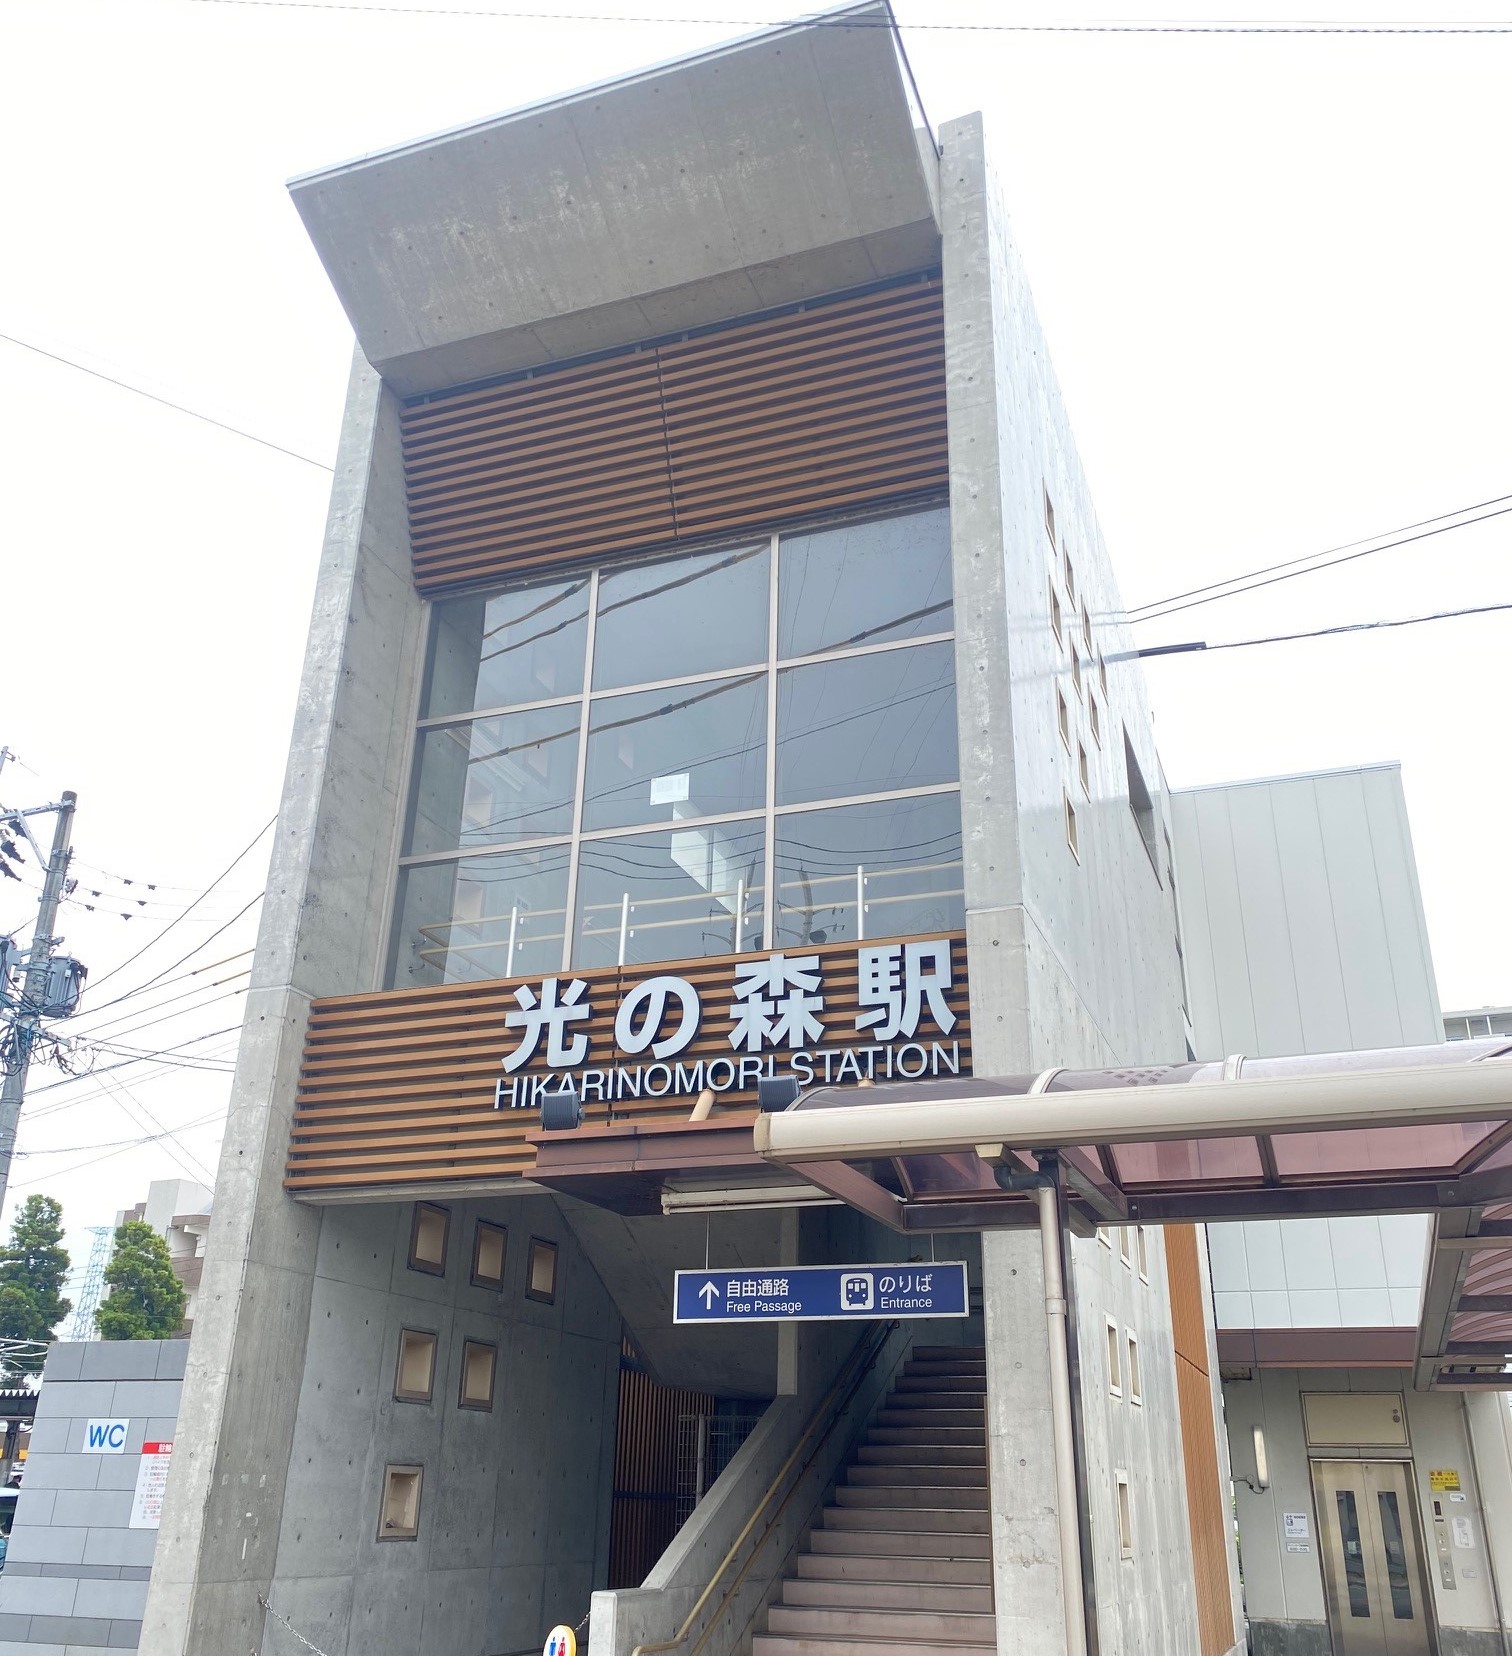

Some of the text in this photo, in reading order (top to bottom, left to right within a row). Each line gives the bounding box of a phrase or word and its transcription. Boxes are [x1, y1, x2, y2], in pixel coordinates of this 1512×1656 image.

[501, 939, 957, 1074] 光の森駅
[494, 1041, 960, 1110] HIKARINOMORI STATION
[726, 1279, 790, 1298] 自由通路
[879, 1273, 933, 1293] のりば
[726, 1300, 802, 1314] Free Passage
[881, 1297, 933, 1309] Entrance
[89, 1424, 125, 1448] WC
